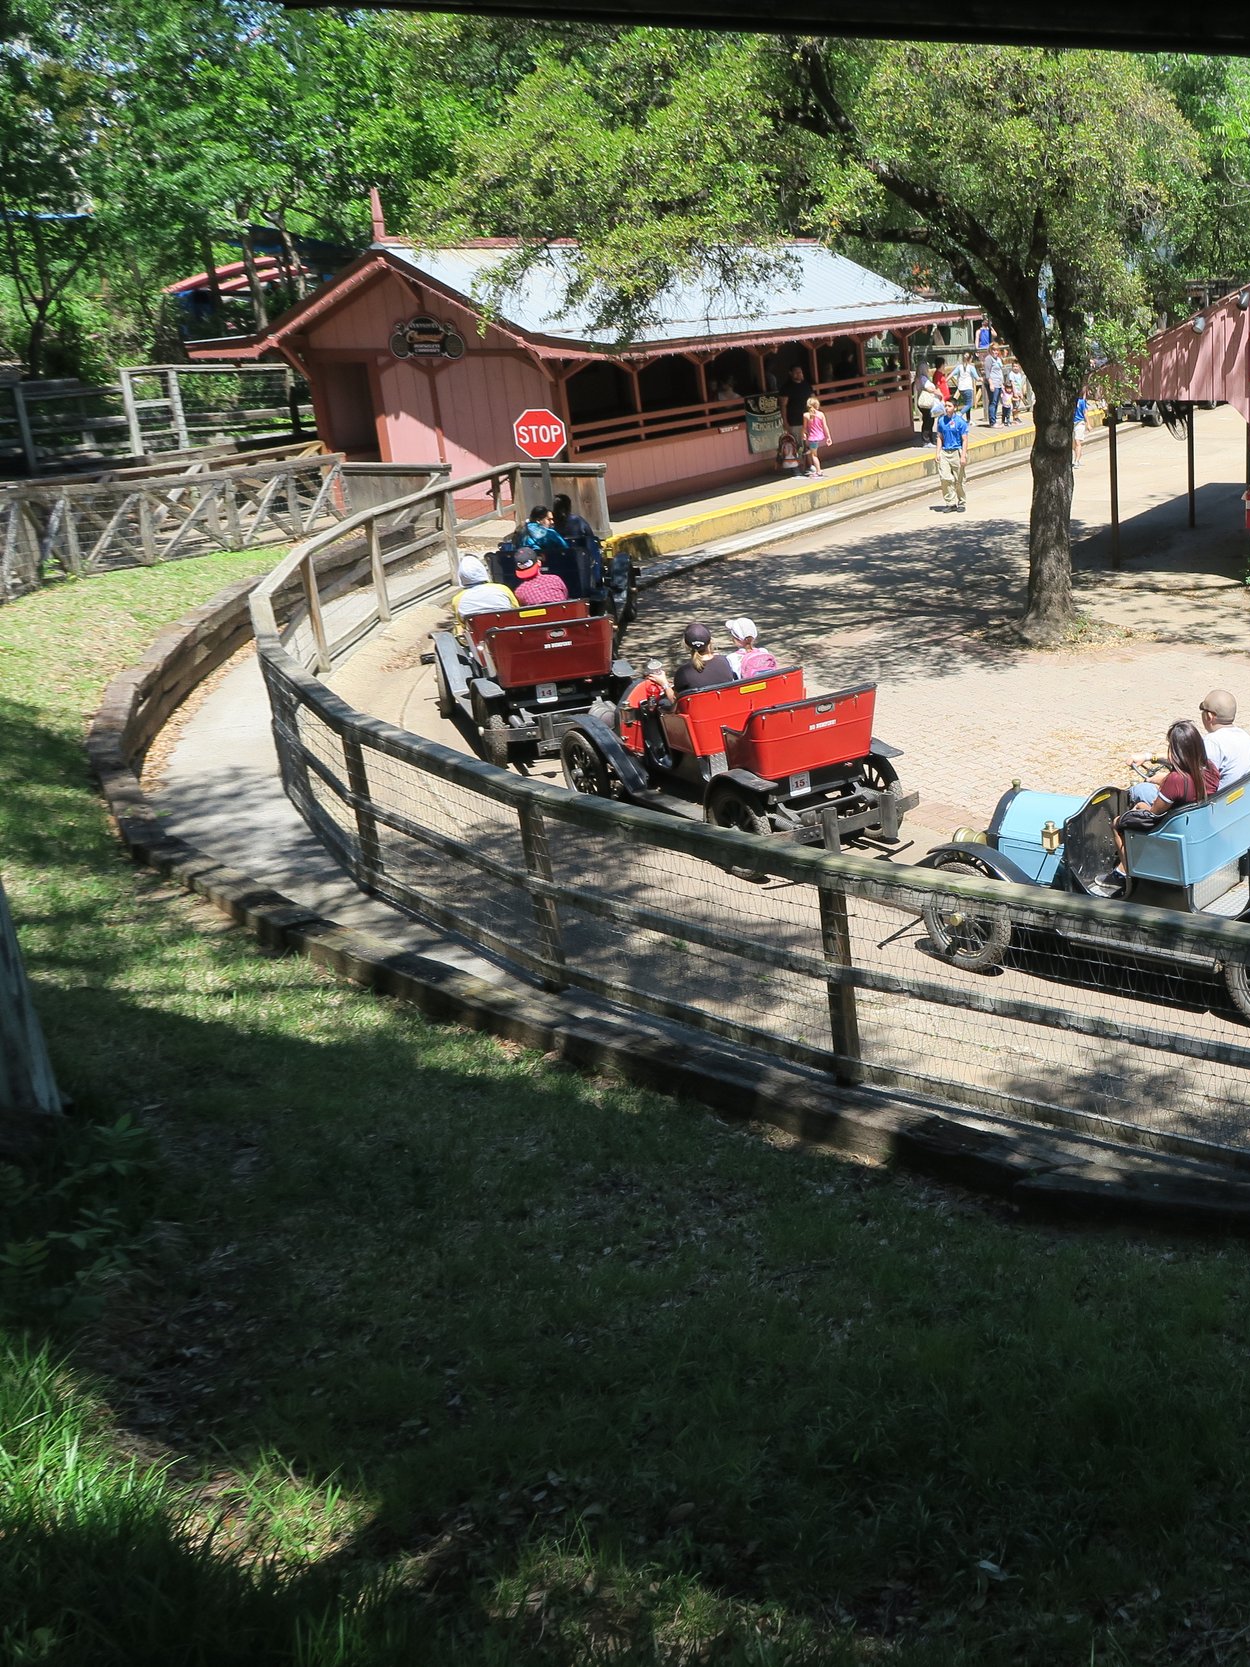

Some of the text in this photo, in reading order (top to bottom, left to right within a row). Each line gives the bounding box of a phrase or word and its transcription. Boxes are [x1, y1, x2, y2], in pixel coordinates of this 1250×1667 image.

[518, 425, 562, 443] STOP
[541, 689, 552, 697] 14
[794, 779, 805, 788] 15
